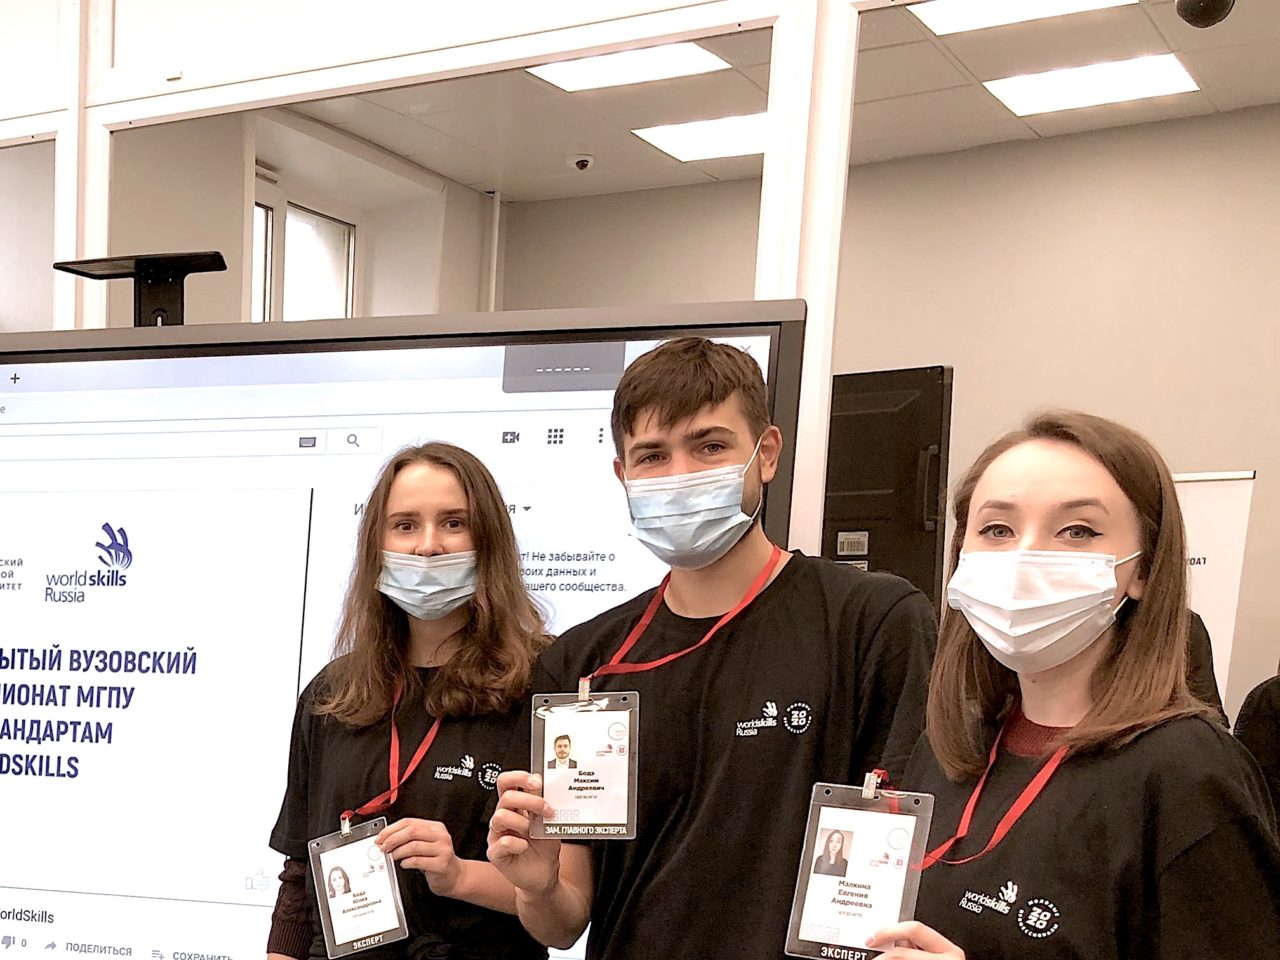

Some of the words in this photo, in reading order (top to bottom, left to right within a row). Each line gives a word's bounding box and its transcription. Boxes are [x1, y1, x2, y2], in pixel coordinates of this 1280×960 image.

[532, 552, 546, 562] Не
[548, 551, 607, 562] забывайте
[608, 553, 616, 562] о
[46, 570, 127, 587] worldskills
[545, 568, 587, 578] данных
[589, 568, 596, 577] и
[558, 582, 627, 593] сообщества.
[45, 586, 85, 603] Russia
[69, 647, 198, 675] ВУЗОВСКИЙ
[76, 686, 135, 709] МГПУ
[736, 728, 758, 737] Russia
[568, 784, 605, 792] Андреевич
[561, 826, 595, 835] ГЛАВНОГО
[594, 826, 627, 835] ЭКСПЕРТА
[959, 897, 983, 914] Russia
[21, 938, 27, 948] 0
[352, 934, 384, 950] ЭКСПЕРТ
[65, 942, 132, 957] ПОДЕЛИТЬСЯ
